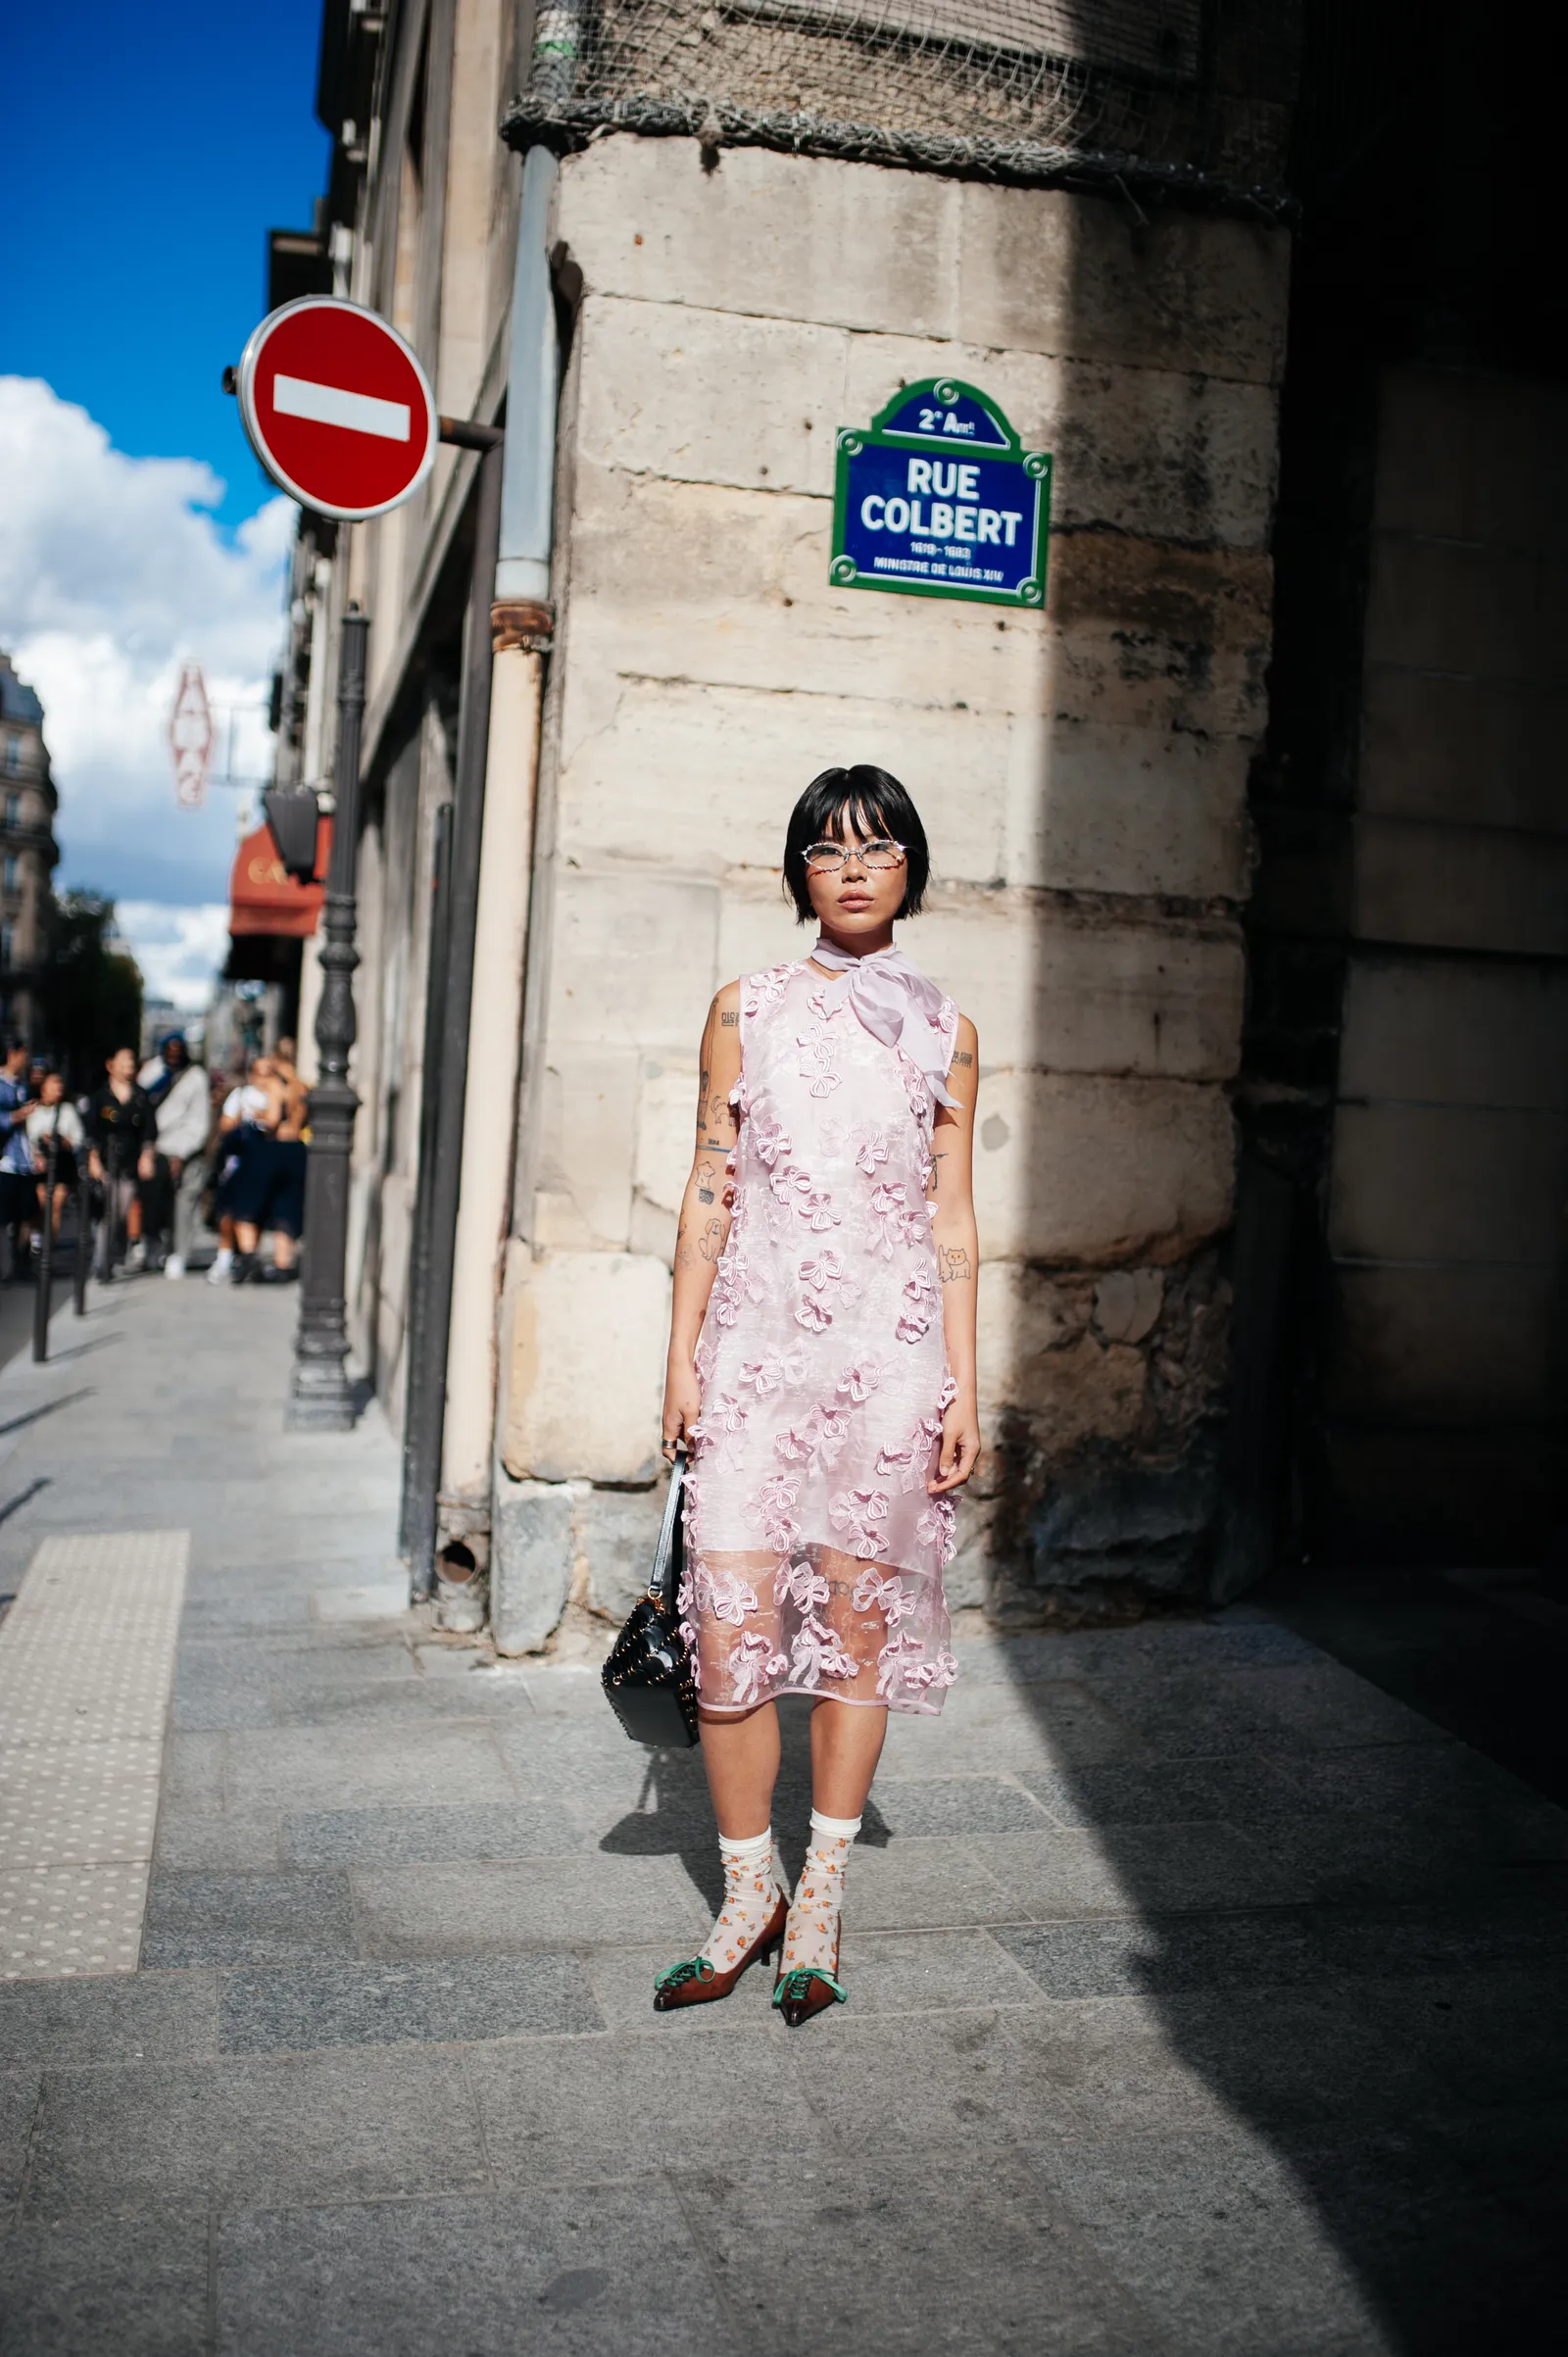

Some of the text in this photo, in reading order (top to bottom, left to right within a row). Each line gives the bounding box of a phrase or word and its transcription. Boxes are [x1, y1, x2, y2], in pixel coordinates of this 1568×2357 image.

[907, 458, 981, 501] RUE
[860, 494, 1023, 547] COLBERT
[874, 557, 1004, 583] MINISTRE DE LOUIS XIV
